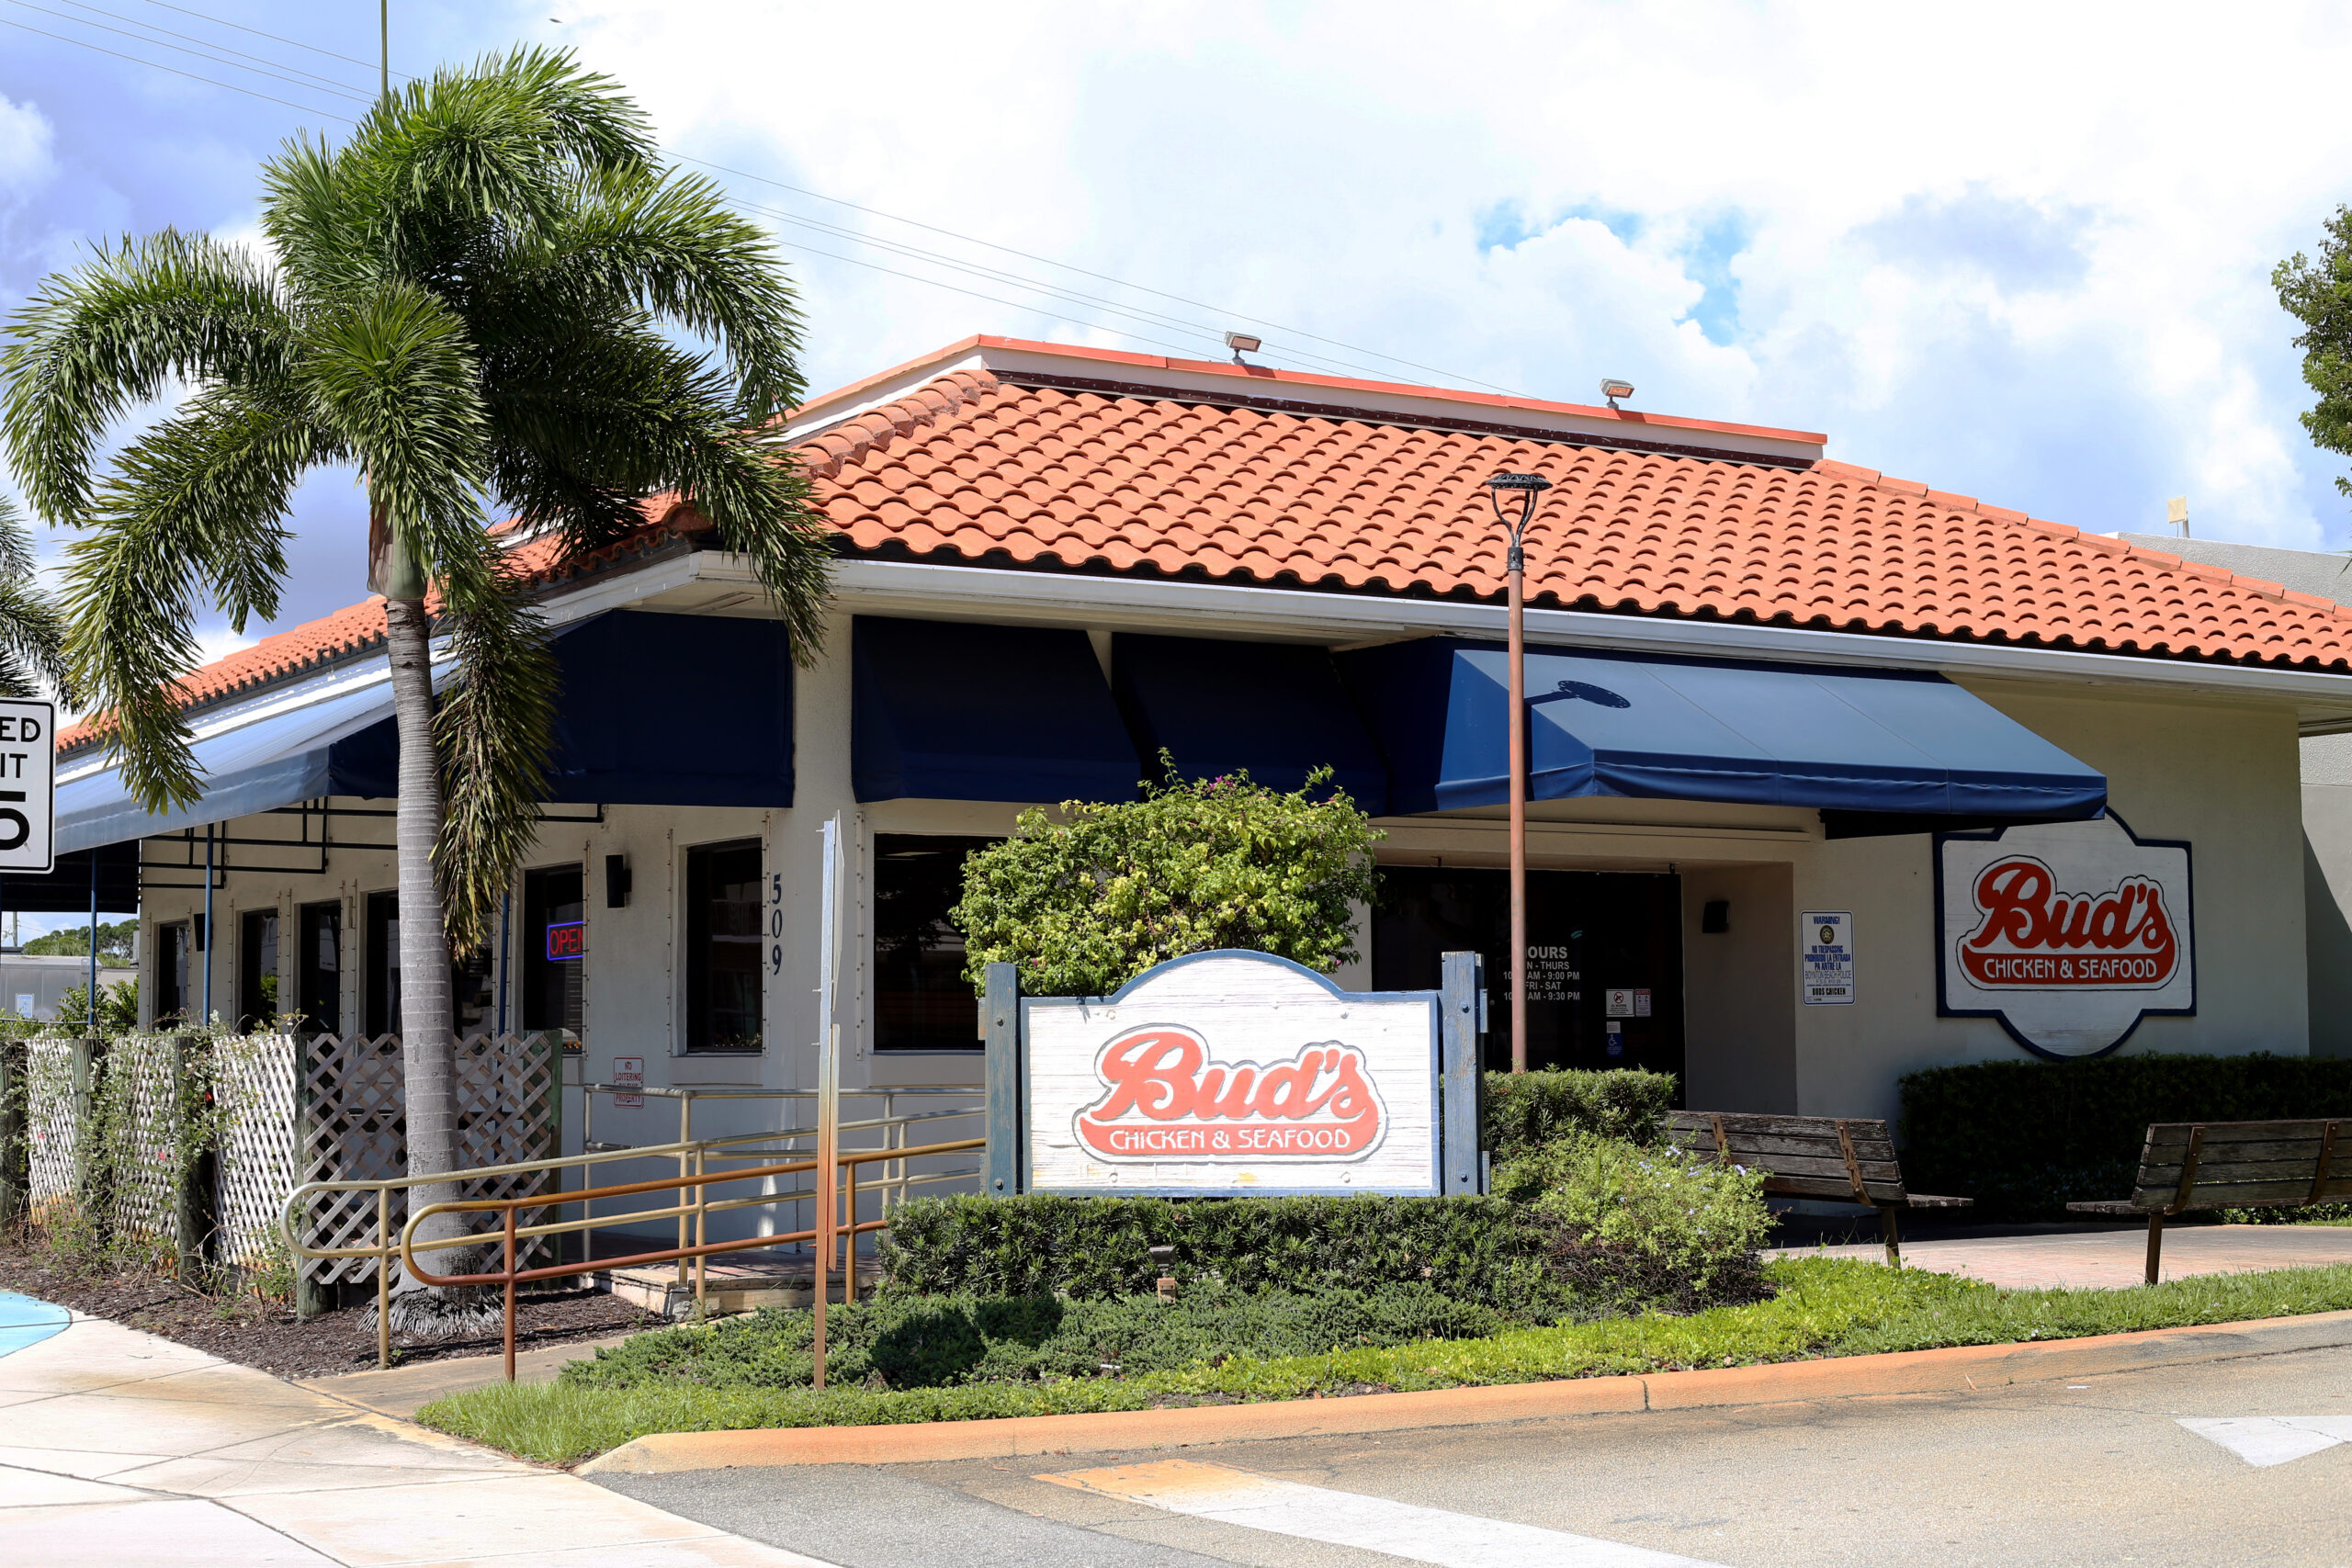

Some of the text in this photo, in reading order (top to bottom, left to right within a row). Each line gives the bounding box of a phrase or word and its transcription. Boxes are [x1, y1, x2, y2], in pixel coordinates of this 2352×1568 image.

[0, 791, 30, 851] 5
[1970, 862, 2170, 949] Bud's
[1814, 916, 1840, 924] WARNING!
[1526, 946, 1567, 959] OURS
[1812, 945, 1843, 953] NO TRESPASSING
[1540, 961, 1570, 970] THURS
[1984, 958, 2157, 978] CHICKEN & SEAFOOD
[1527, 971, 1541, 980] AM
[1547, 971, 1565, 980] 9:00
[1566, 971, 1579, 980] PM
[1545, 981, 1561, 990] SAT
[1527, 992, 1541, 1000] AM
[1548, 992, 1565, 1000] 9:30
[1567, 992, 1580, 1000] PM
[625, 1061, 632, 1070] NO
[616, 1073, 641, 1081] LOITERING
[1091, 1032, 1369, 1120] Bud's
[616, 1093, 641, 1102] PROPERTY
[1109, 1128, 1351, 1149] CHICKEN & SEAFOOD
